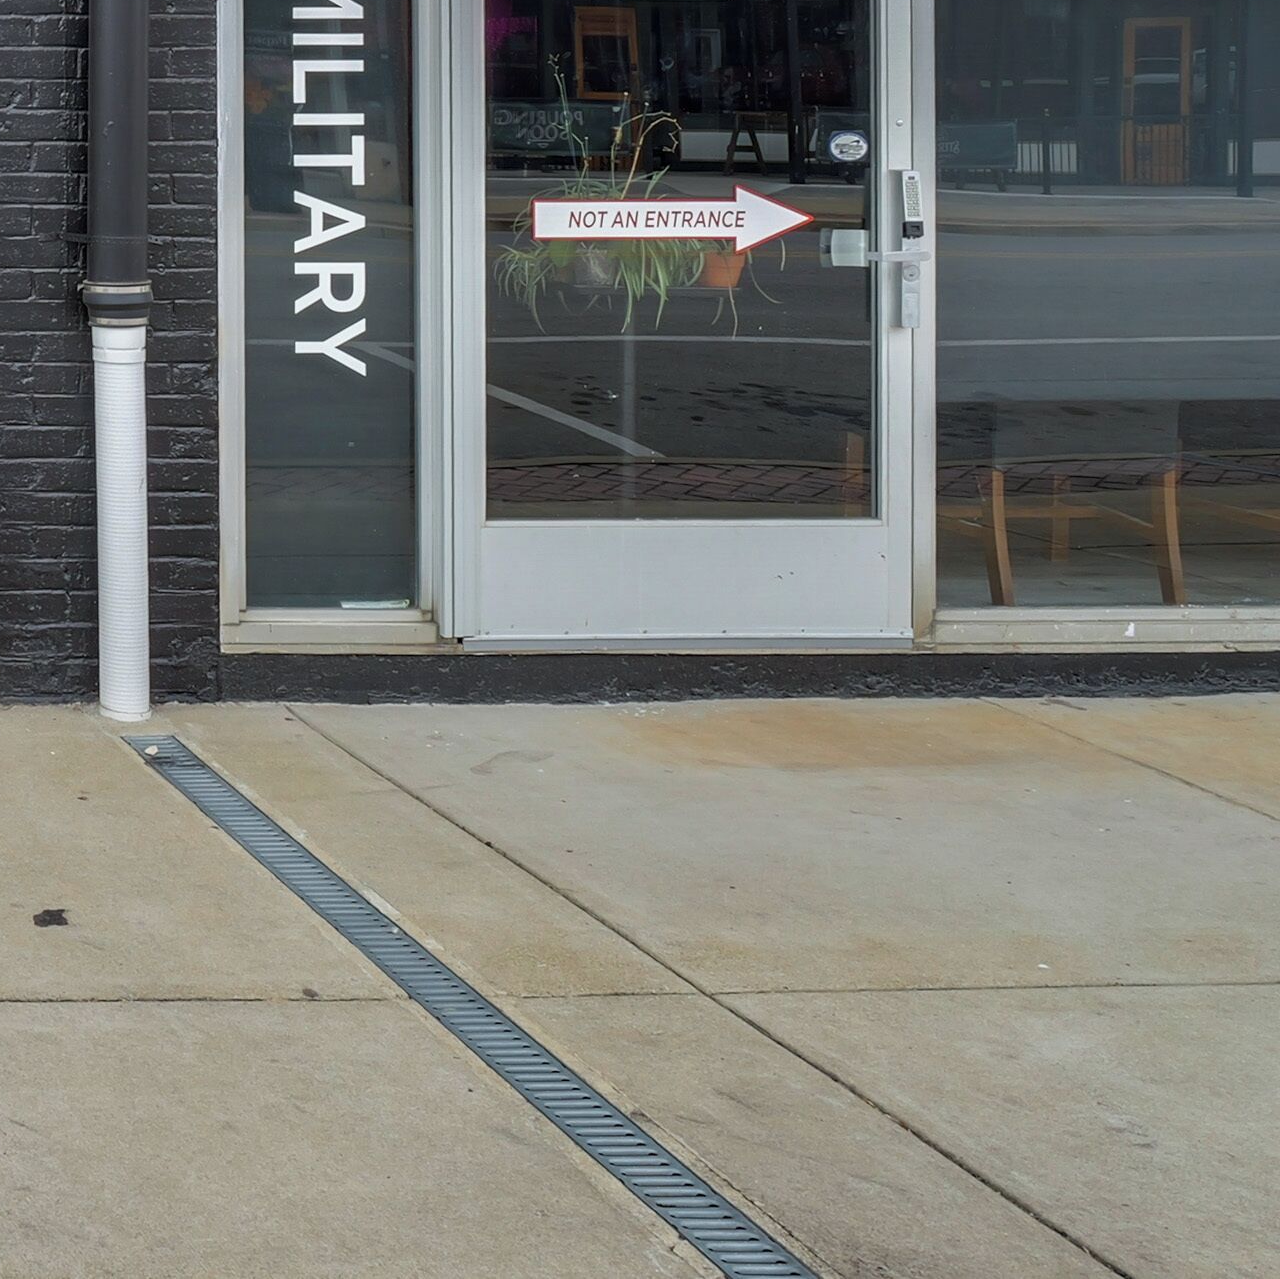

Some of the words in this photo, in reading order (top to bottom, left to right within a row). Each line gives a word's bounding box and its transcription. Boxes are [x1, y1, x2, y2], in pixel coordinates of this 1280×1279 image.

[568, 210, 608, 229] NOT
[611, 210, 638, 229] AN
[645, 210, 746, 229] ENTRANCE
